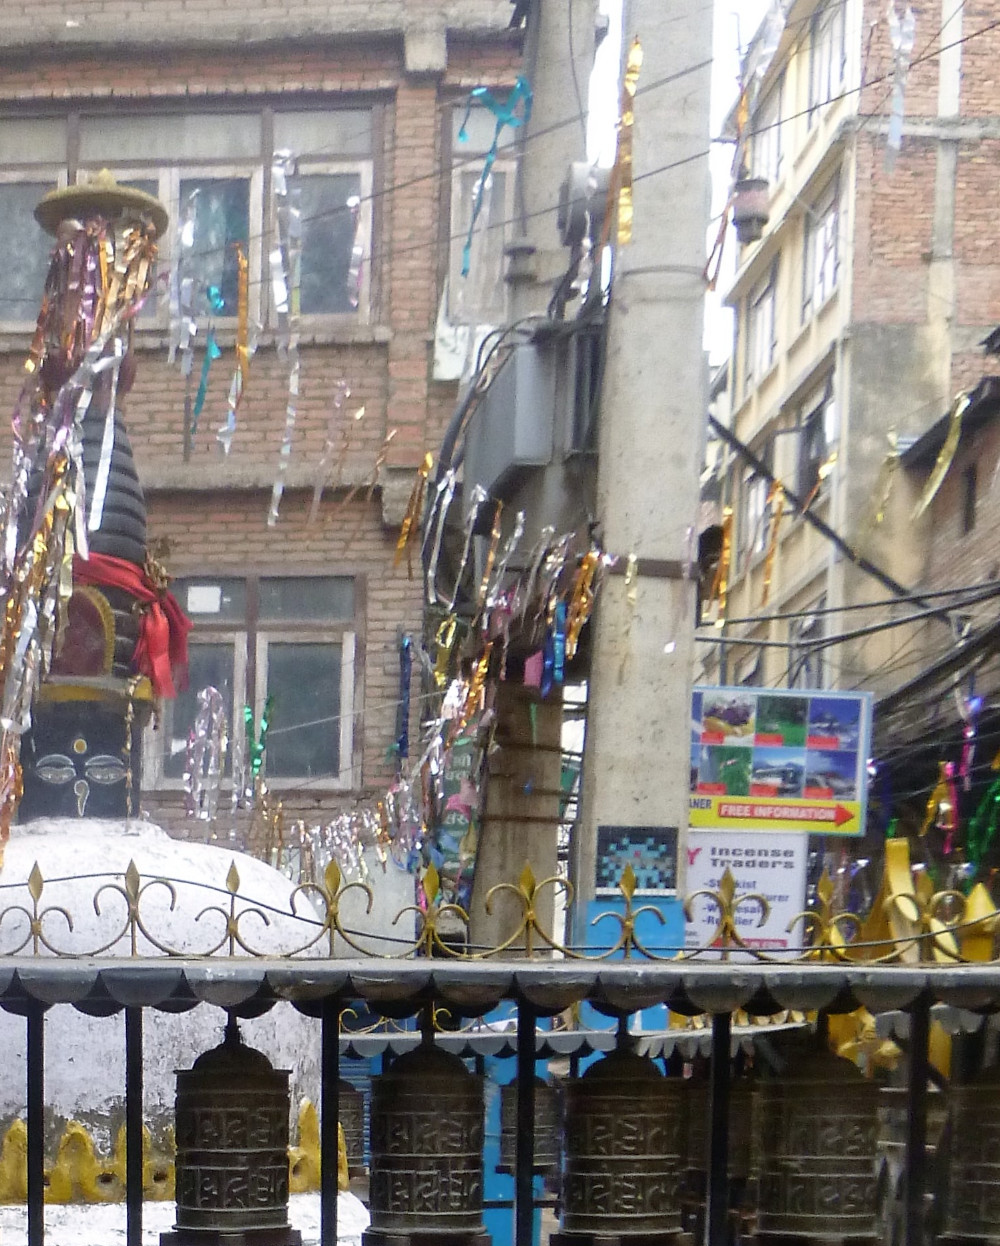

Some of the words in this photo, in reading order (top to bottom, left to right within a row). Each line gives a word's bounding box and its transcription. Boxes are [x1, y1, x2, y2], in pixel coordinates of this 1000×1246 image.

[720, 804, 751, 817] FREE
[754, 806, 836, 822] INFORMATION
[711, 846, 795, 858] Incense
[710, 858, 795, 870] Traders
[703, 878, 757, 889] -Stkist
